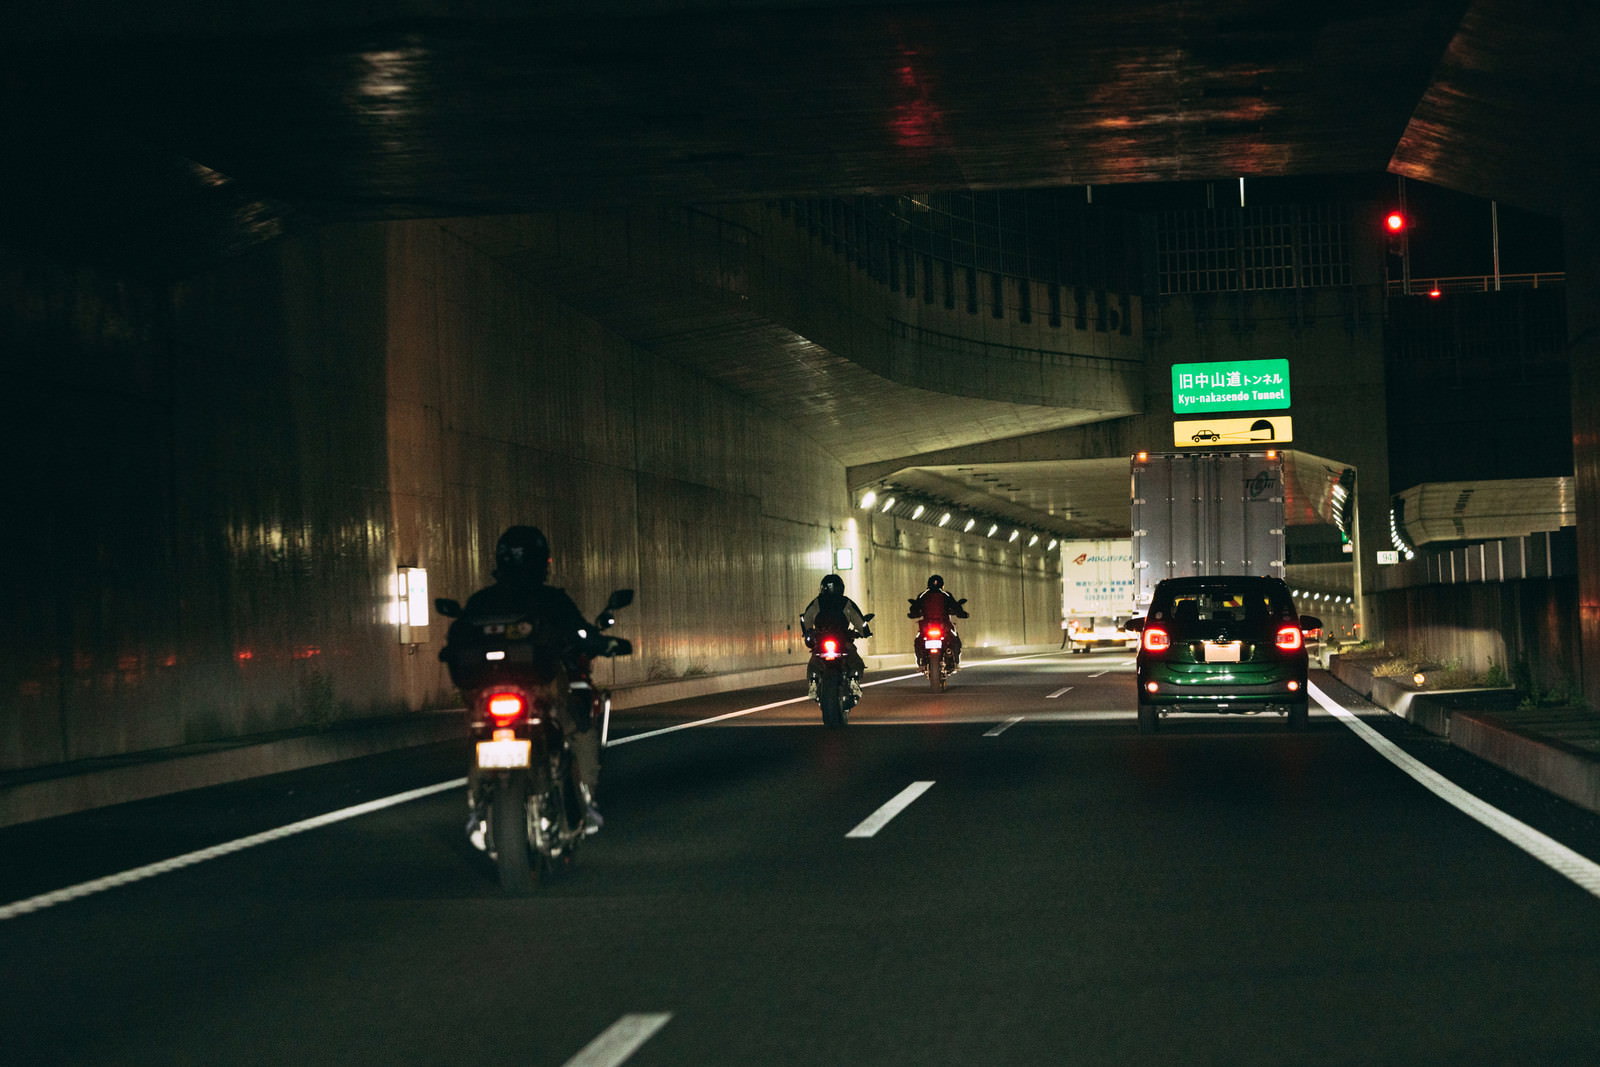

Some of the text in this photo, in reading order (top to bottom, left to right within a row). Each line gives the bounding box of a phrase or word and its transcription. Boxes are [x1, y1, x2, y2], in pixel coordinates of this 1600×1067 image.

[1179, 371, 1283, 390] 旧中山道トンネル
[1178, 389, 1285, 406] Kyu-nakasendo Tunnel
